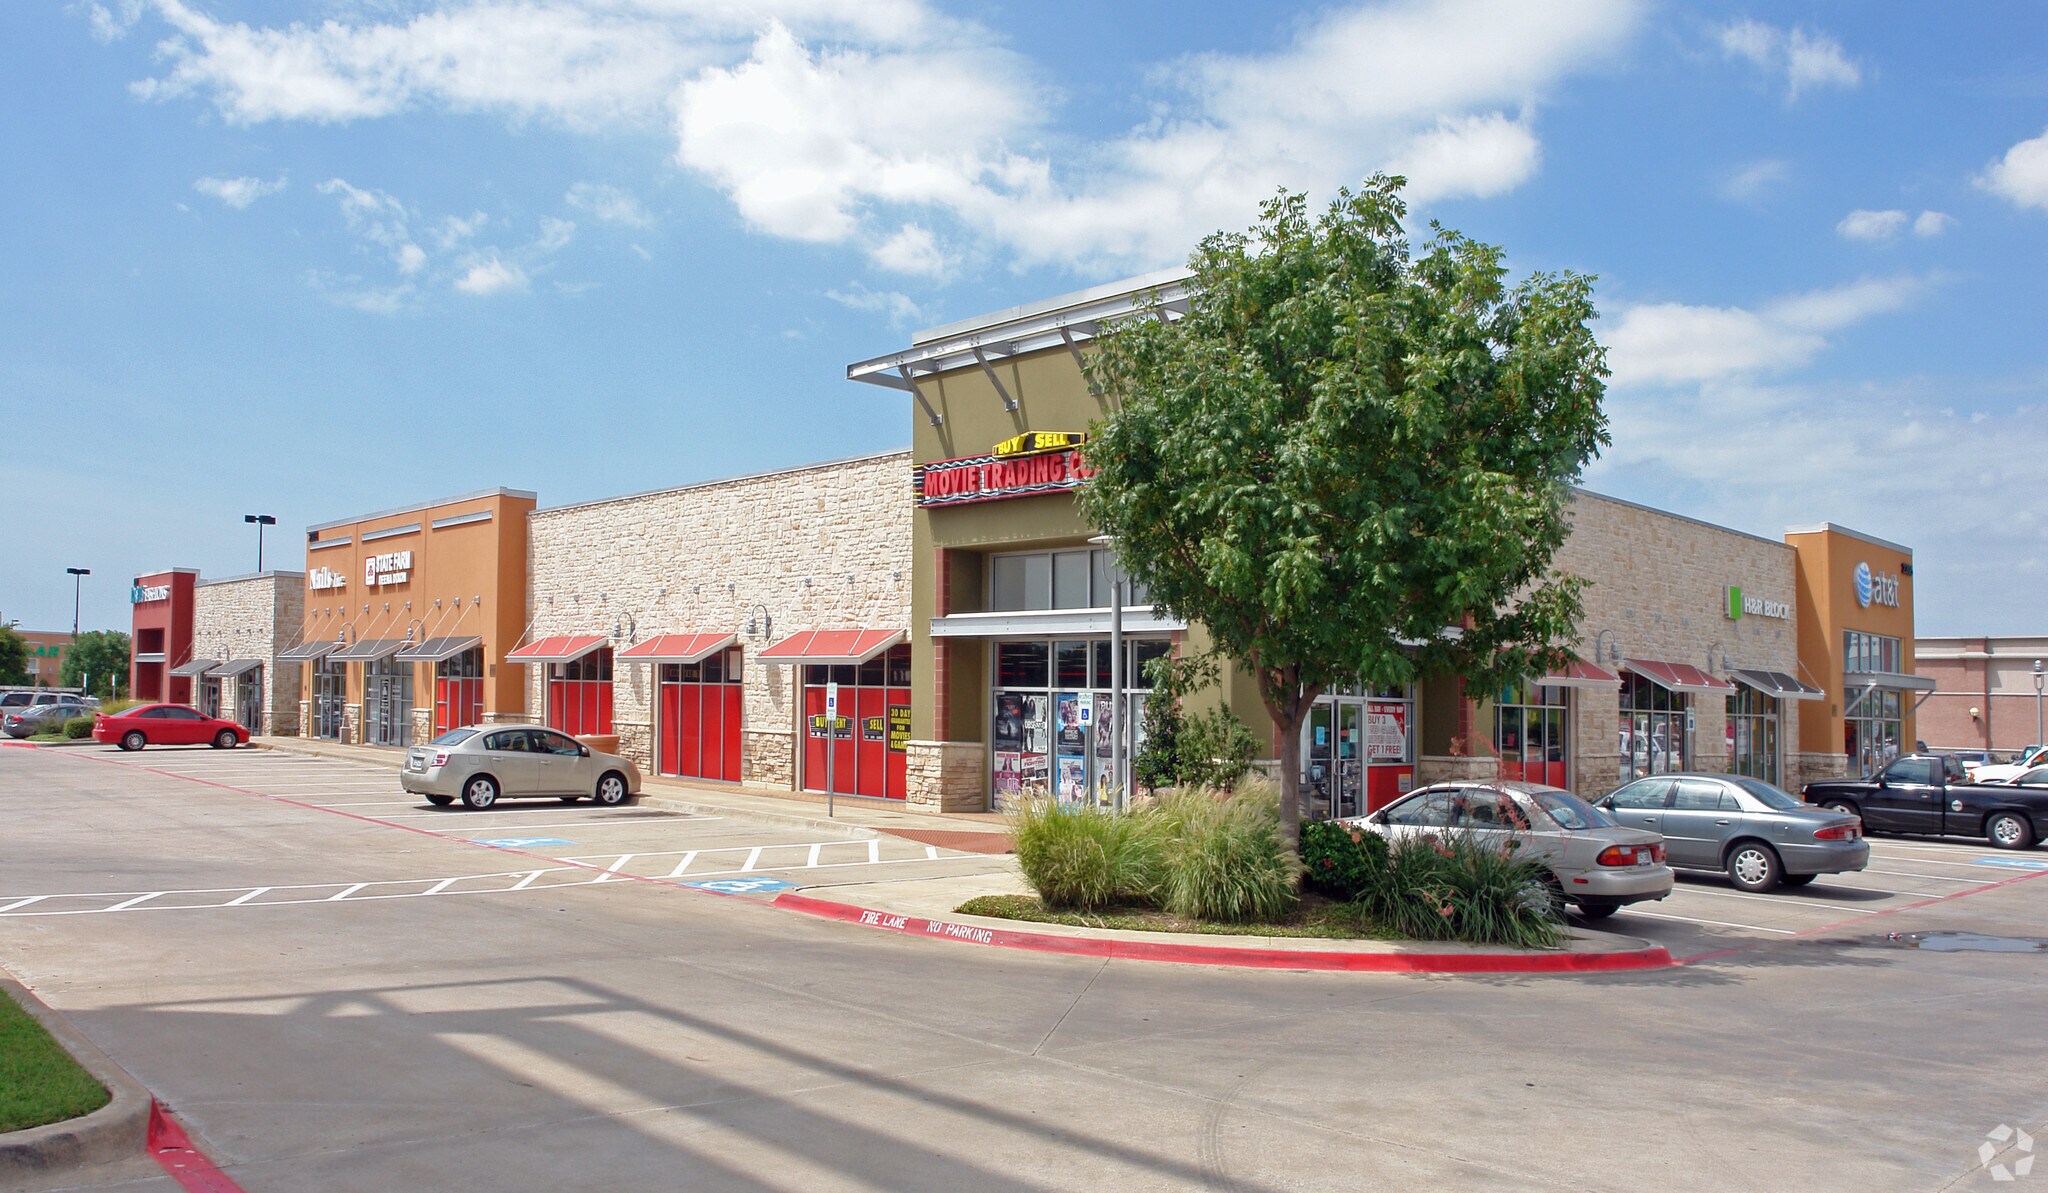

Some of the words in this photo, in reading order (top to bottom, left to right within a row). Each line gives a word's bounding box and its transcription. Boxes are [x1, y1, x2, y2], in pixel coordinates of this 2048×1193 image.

[998, 435, 1025, 455] BUY
[1034, 433, 1070, 449] SELL
[924, 465, 982, 497] MOVIE
[981, 452, 1068, 490] TRADING
[375, 553, 394, 573] STATE
[394, 550, 412, 571] FARM
[309, 566, 333, 590] Nails
[1744, 597, 1763, 615] H&R
[1764, 600, 1791, 620] BLOCK
[890, 708, 899, 717] 30
[899, 709, 911, 718] DAY
[1367, 715, 1381, 725] BUY
[1382, 715, 1387, 725] 3
[869, 718, 883, 731] SELL
[890, 730, 911, 740] MOVIES
[1367, 745, 1380, 754] GET
[859, 910, 882, 925] FIRE
[882, 914, 909, 929] LANE
[926, 920, 943, 933] NO
[945, 923, 993, 944] PARKING
